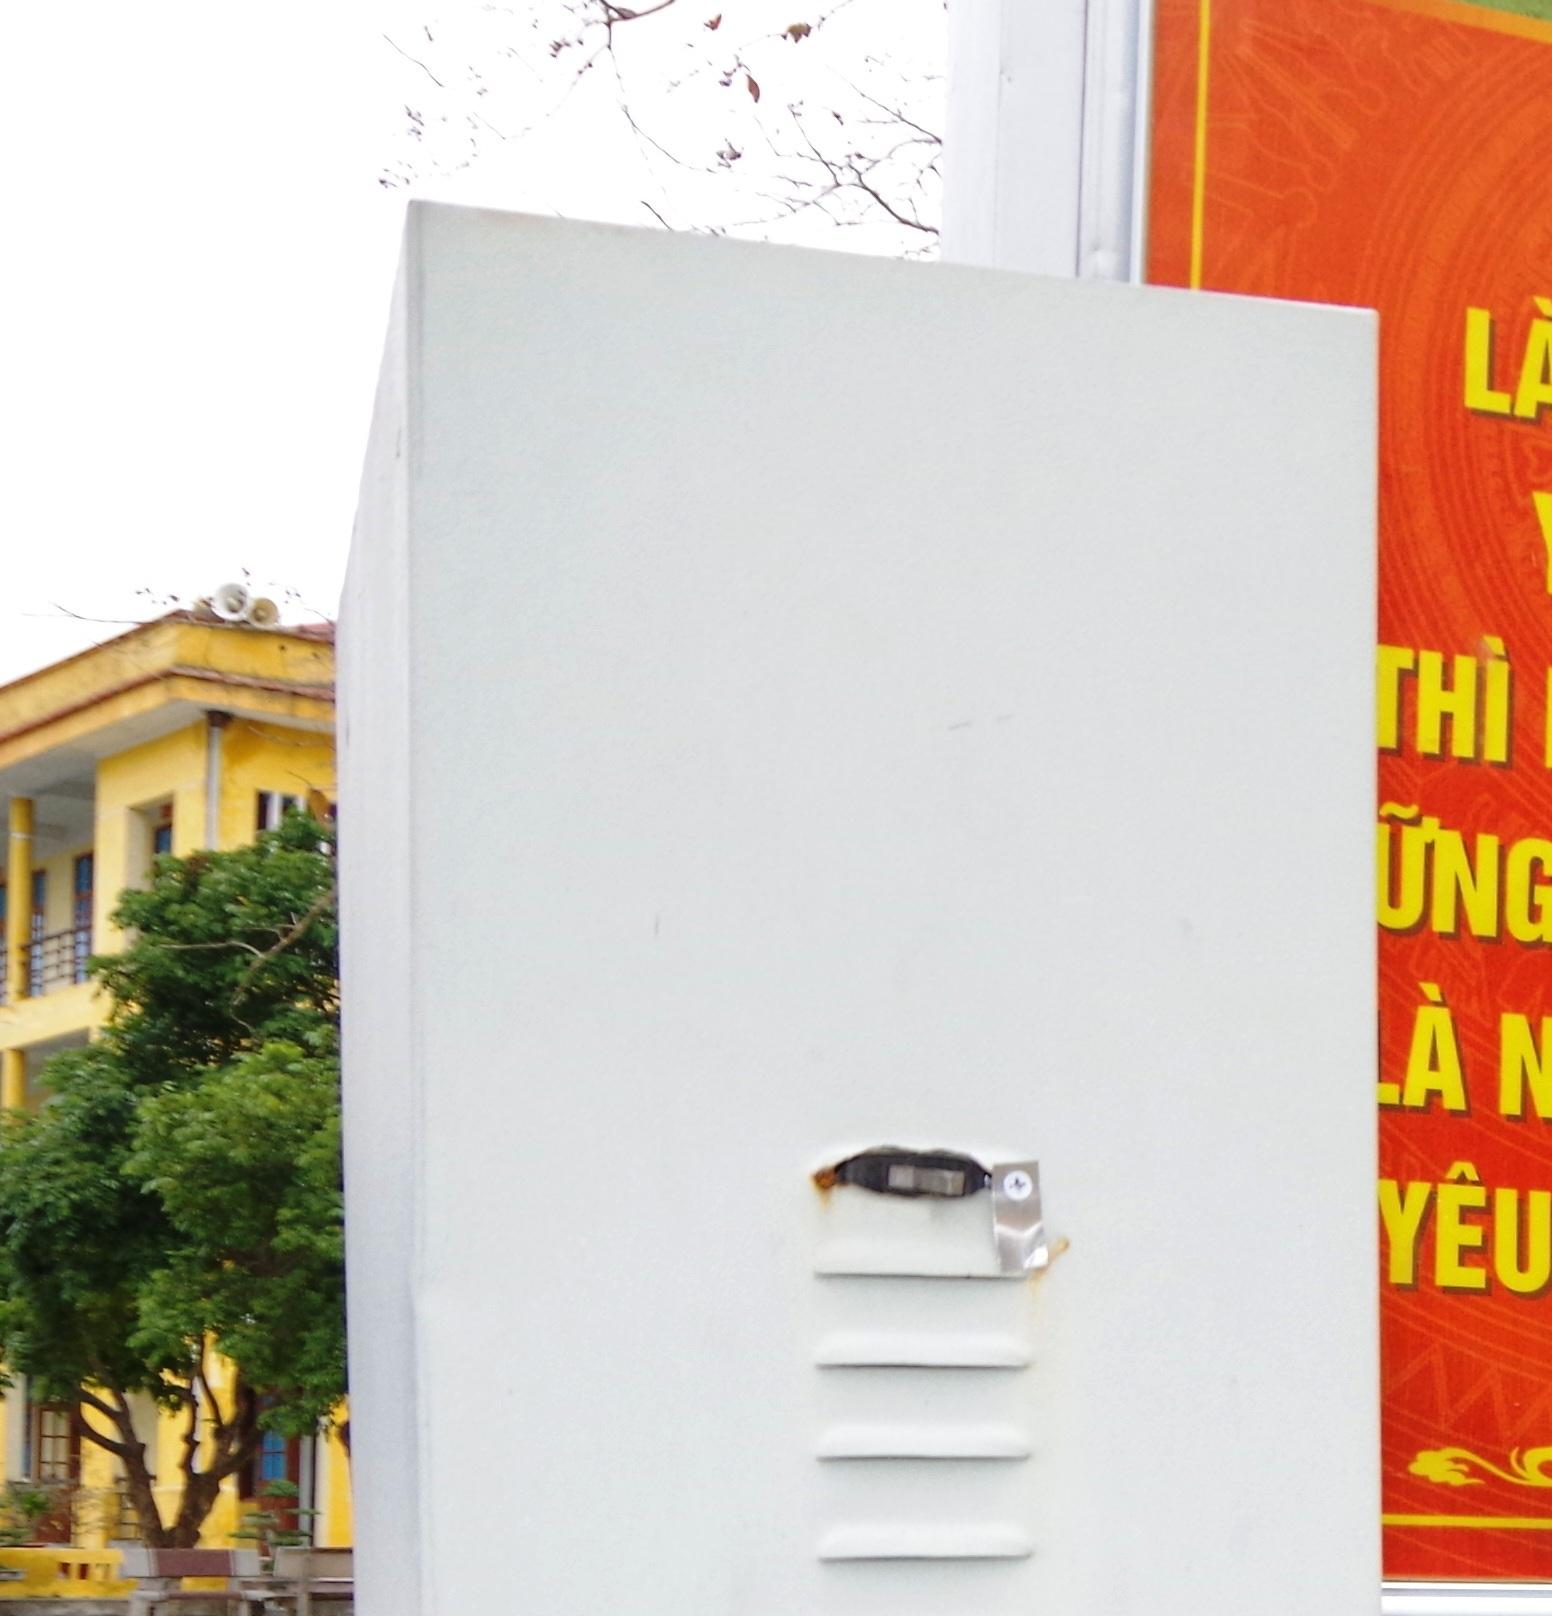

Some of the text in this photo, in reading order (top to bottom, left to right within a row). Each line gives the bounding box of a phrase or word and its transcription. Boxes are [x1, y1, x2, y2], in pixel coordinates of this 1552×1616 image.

[1376, 636, 1511, 764] THÌ
[1377, 982, 1467, 1113] À
[1377, 1162, 1552, 1294] YÊU
